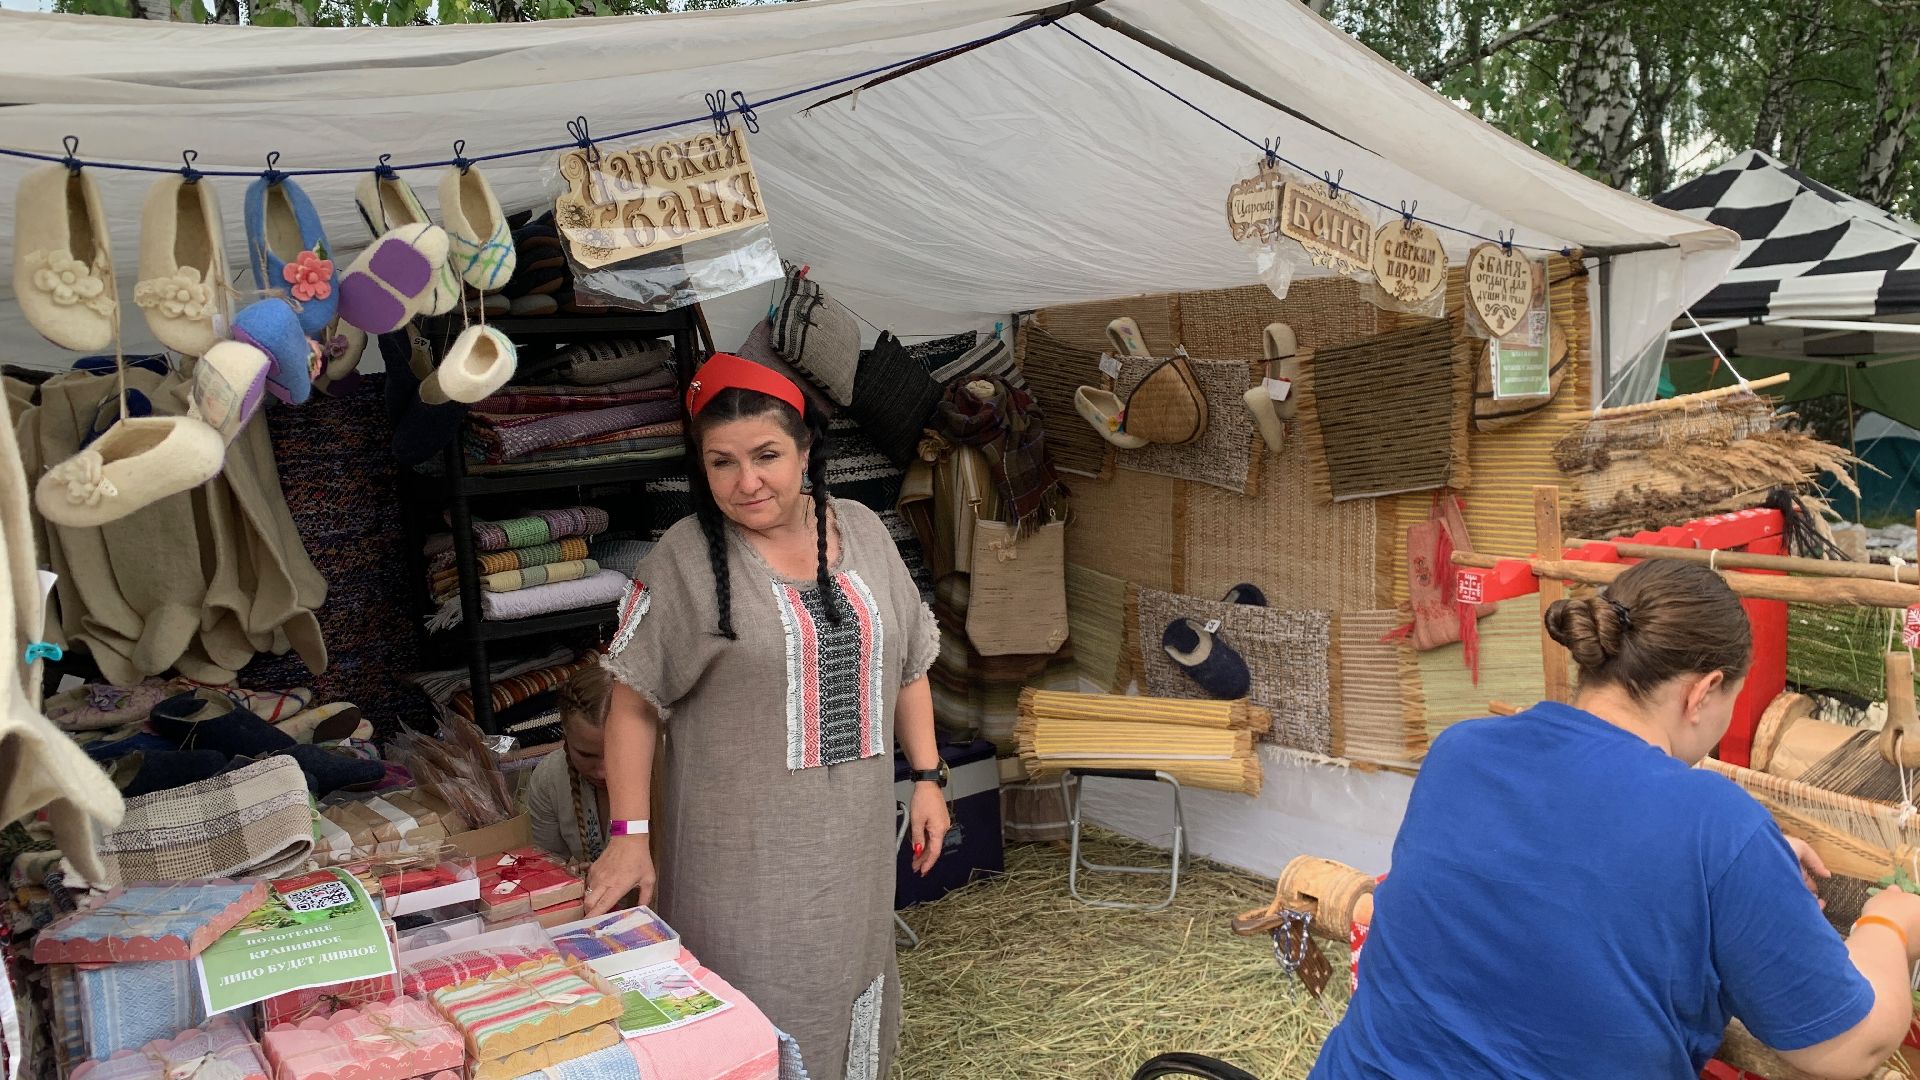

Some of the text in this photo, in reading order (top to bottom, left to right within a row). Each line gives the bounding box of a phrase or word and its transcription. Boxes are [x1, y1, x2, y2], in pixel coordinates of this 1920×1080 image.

[1234, 199, 1275, 223] Царская
[1293, 197, 1369, 261] БАНЯ
[1384, 240, 1392, 255] С
[1387, 260, 1431, 283] ПАРОМ!
[246, 923, 333, 945] ПОЛОТЕНЦЕ
[249, 935, 342, 961] КРАПИВНОЕ
[219, 944, 378, 987] ЛИЦО БУДЕТ ДИВНОЕ
